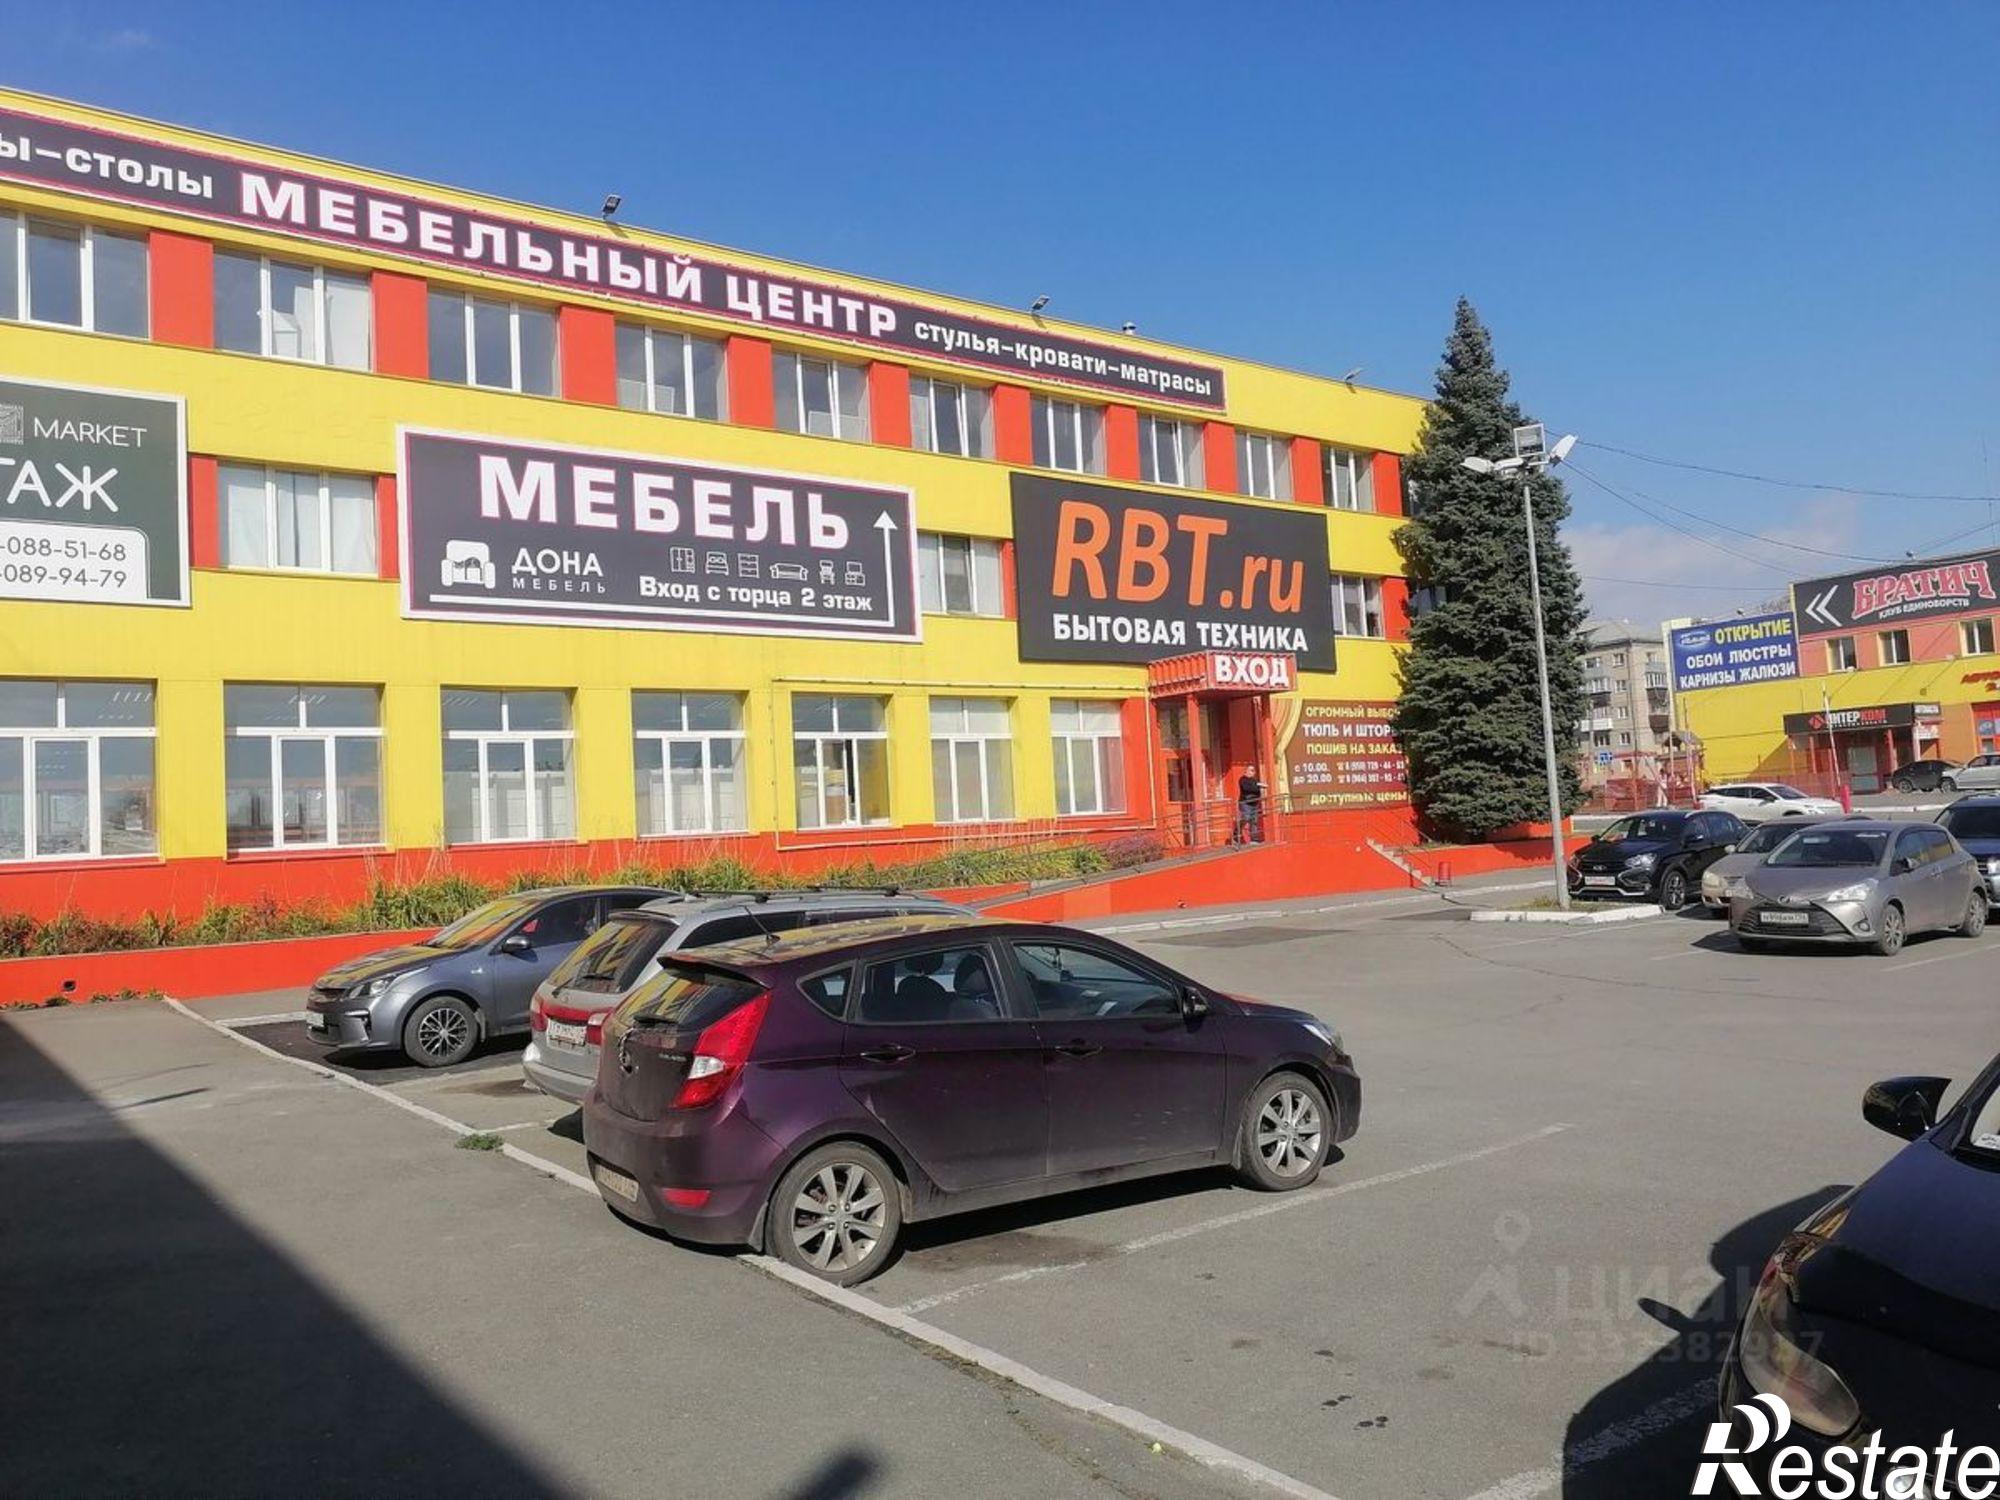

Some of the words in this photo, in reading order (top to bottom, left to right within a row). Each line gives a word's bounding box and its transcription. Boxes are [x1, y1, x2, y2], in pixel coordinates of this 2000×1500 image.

[241, 172, 702, 303] МЕБЕЛЬНЫЙ
[726, 275, 898, 338] ЦЕНТР
[914, 320, 1212, 396] стулья-кровати-матрасы
[34, 416, 147, 448] MARKET
[477, 454, 849, 549] МЕБЕЛЬ
[511, 547, 603, 577] ДОНА
[1052, 500, 1305, 613] RBT.ru
[512, 577, 606, 593] МЕБЕЛЬ
[640, 577, 699, 602] Вход
[707, 585, 721, 600] с
[727, 586, 791, 607] торца
[801, 587, 816, 608] 2
[823, 592, 872, 611] этаж
[1851, 560, 1997, 620] БРАТИЧ
[1879, 604, 1902, 619] КЛУБ
[1053, 613, 1186, 646] БЫТОВАЯ
[1196, 621, 1309, 651] ТЕХНИКА
[1714, 618, 1792, 645] ОТКРЫТИЕ
[1214, 656, 1289, 687] ВХОД
[1686, 652, 1723, 669] ОБОИ
[1729, 644, 1791, 664] ЛЮСТРЫ
[1680, 669, 1735, 689] КАРНИЗЫ
[1740, 661, 1796, 681] ЖАЛЮЗИ
[1305, 705, 1364, 718] ОГРОМНЫЙ
[1302, 723, 1339, 737] ТЮЛЬ
[1343, 724, 1352, 737] И
[1306, 743, 1347, 755] ПОШИВ
[1350, 743, 1365, 754] НА
